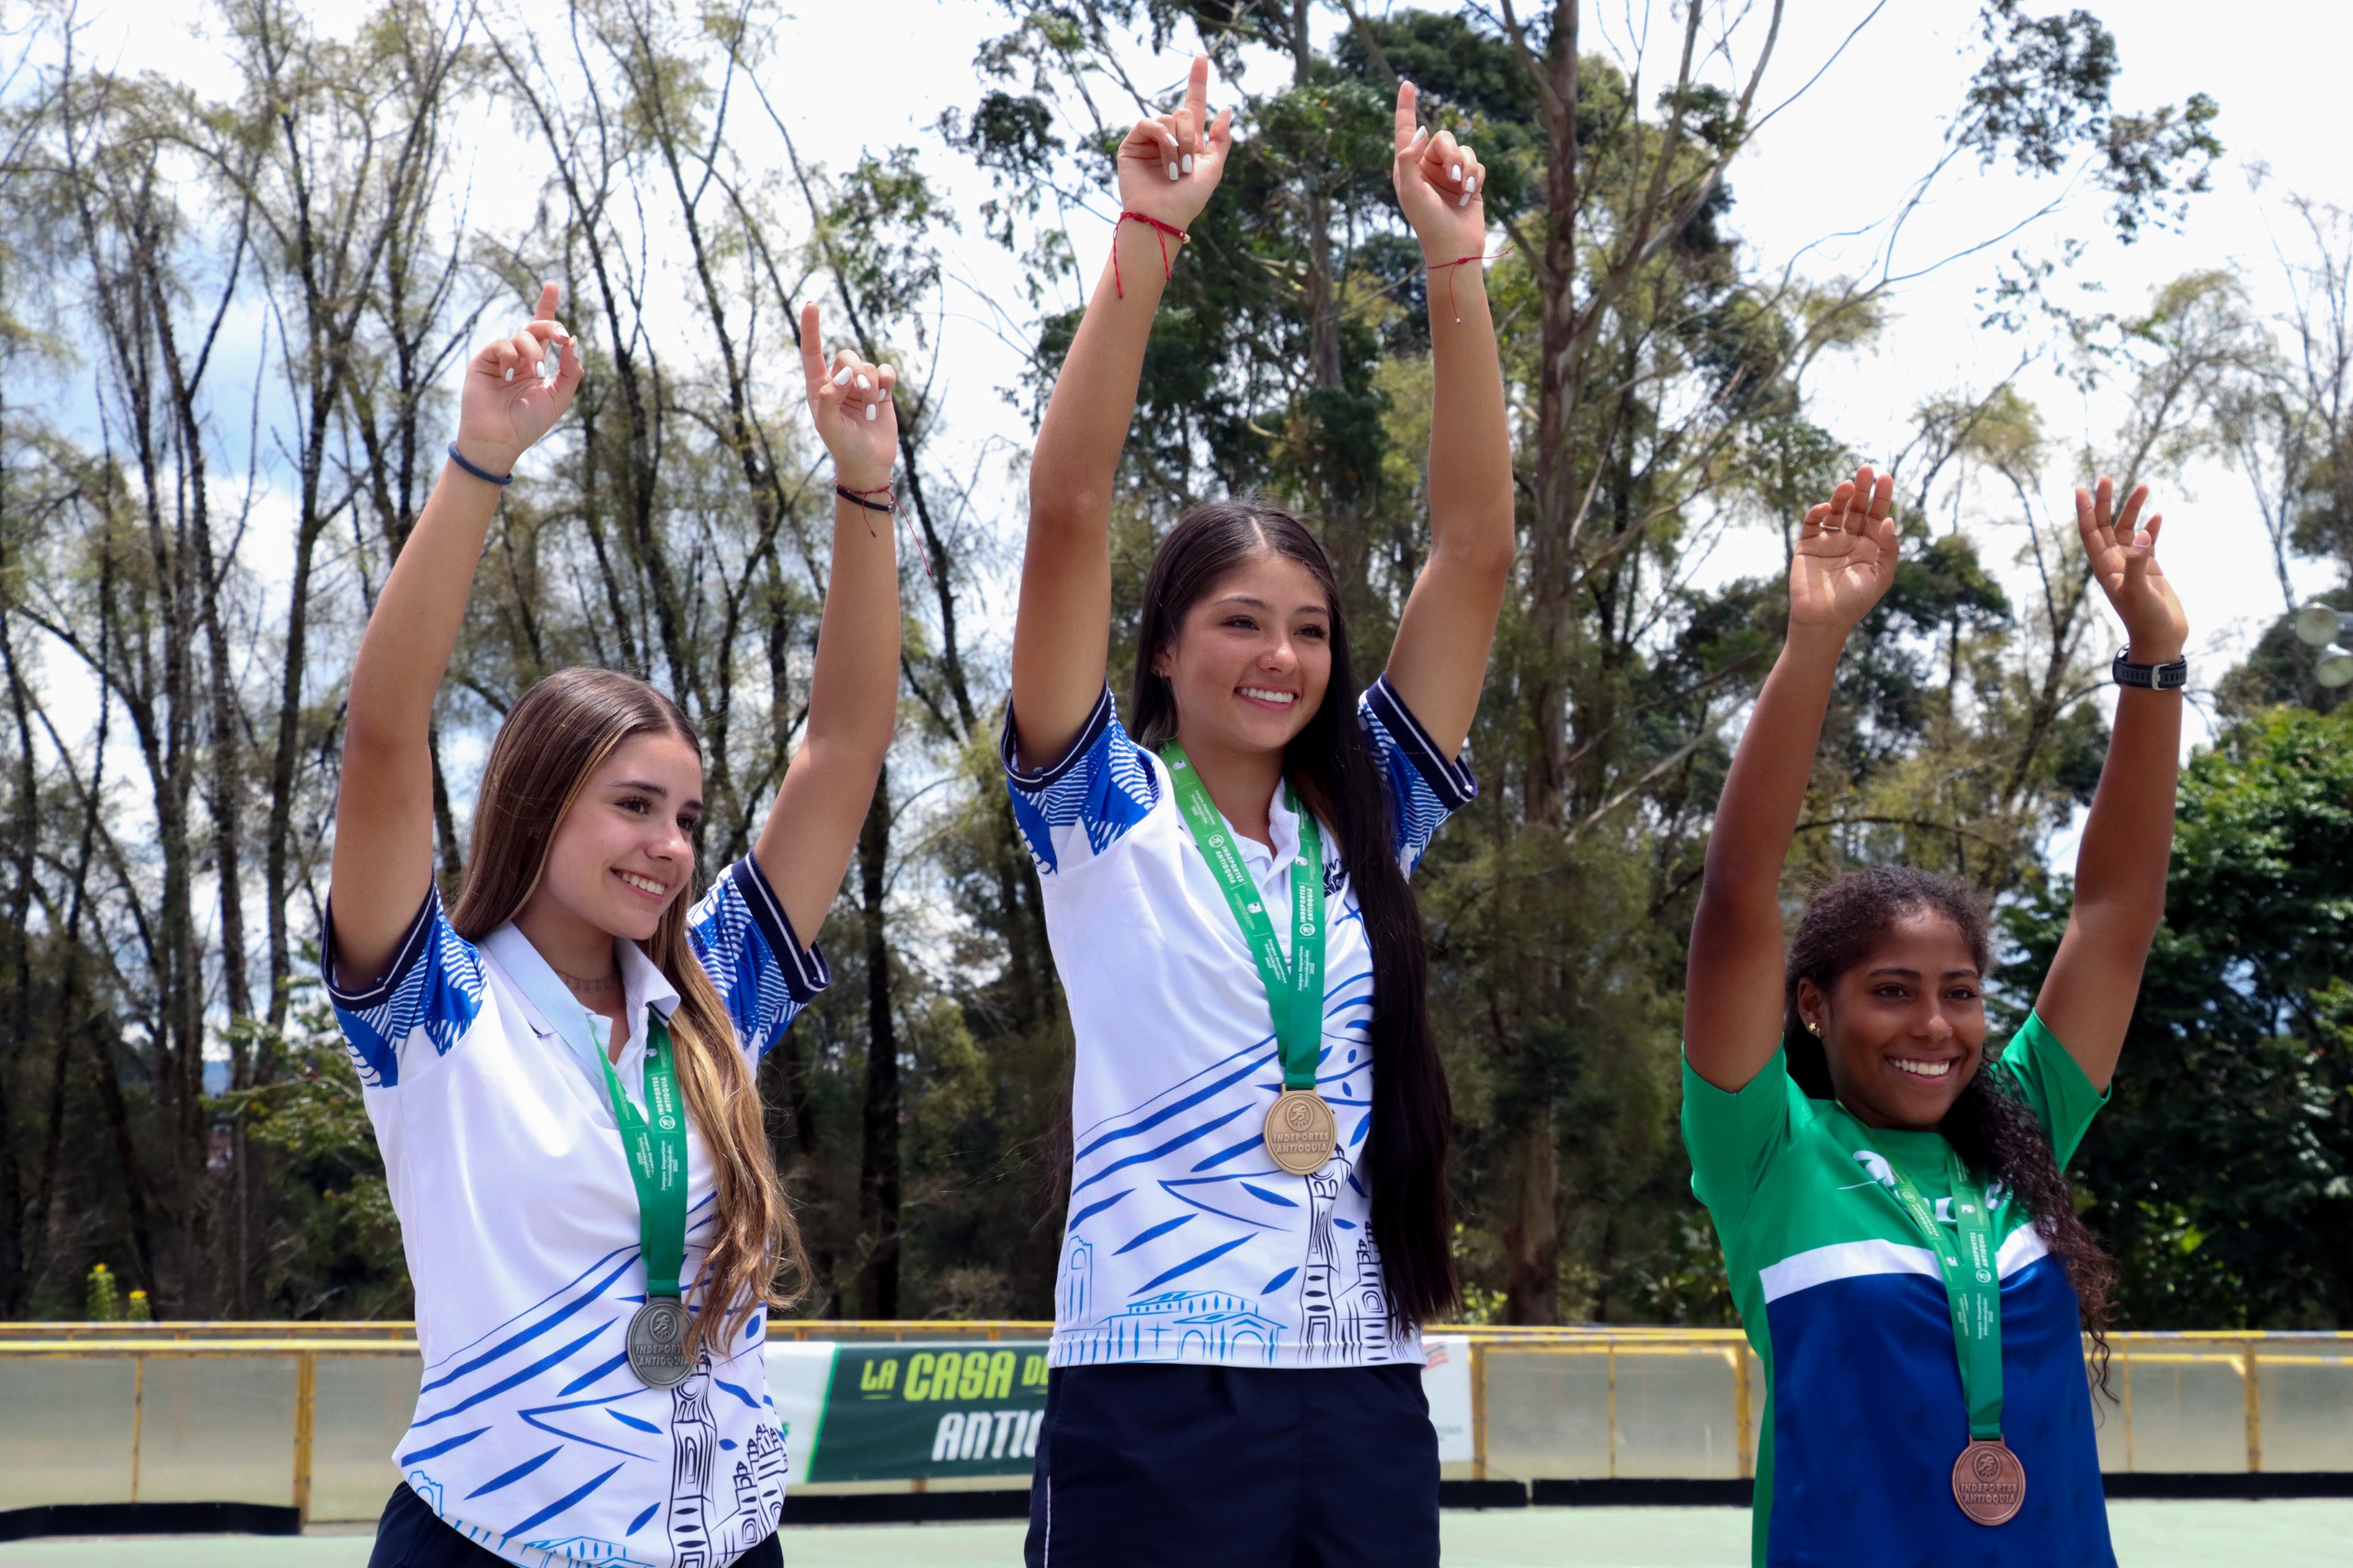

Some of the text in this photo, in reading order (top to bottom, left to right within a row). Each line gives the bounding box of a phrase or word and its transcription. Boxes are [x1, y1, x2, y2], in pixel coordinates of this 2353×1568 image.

[1215, 850, 1236, 884] ANTIOQUIA
[1222, 846, 1245, 883] INDEPORTES
[652, 1076, 664, 1115] INDEPORTES
[661, 1076, 673, 1113] ANTIOQUIA
[1273, 1131, 1330, 1142] INDEPORTES
[1277, 1142, 1327, 1154] ANTIOQUIA
[1970, 1232, 1982, 1269] INDEPORTES
[1977, 1233, 1989, 1267] ANTIOQUIA
[636, 1344, 684, 1355] INDEPORT
[860, 1359, 899, 1391] LA
[903, 1351, 1017, 1402] CASA
[1961, 1483, 2018, 1493] INDEPORTES
[1964, 1494, 2016, 1506] ANTIOQUIA
